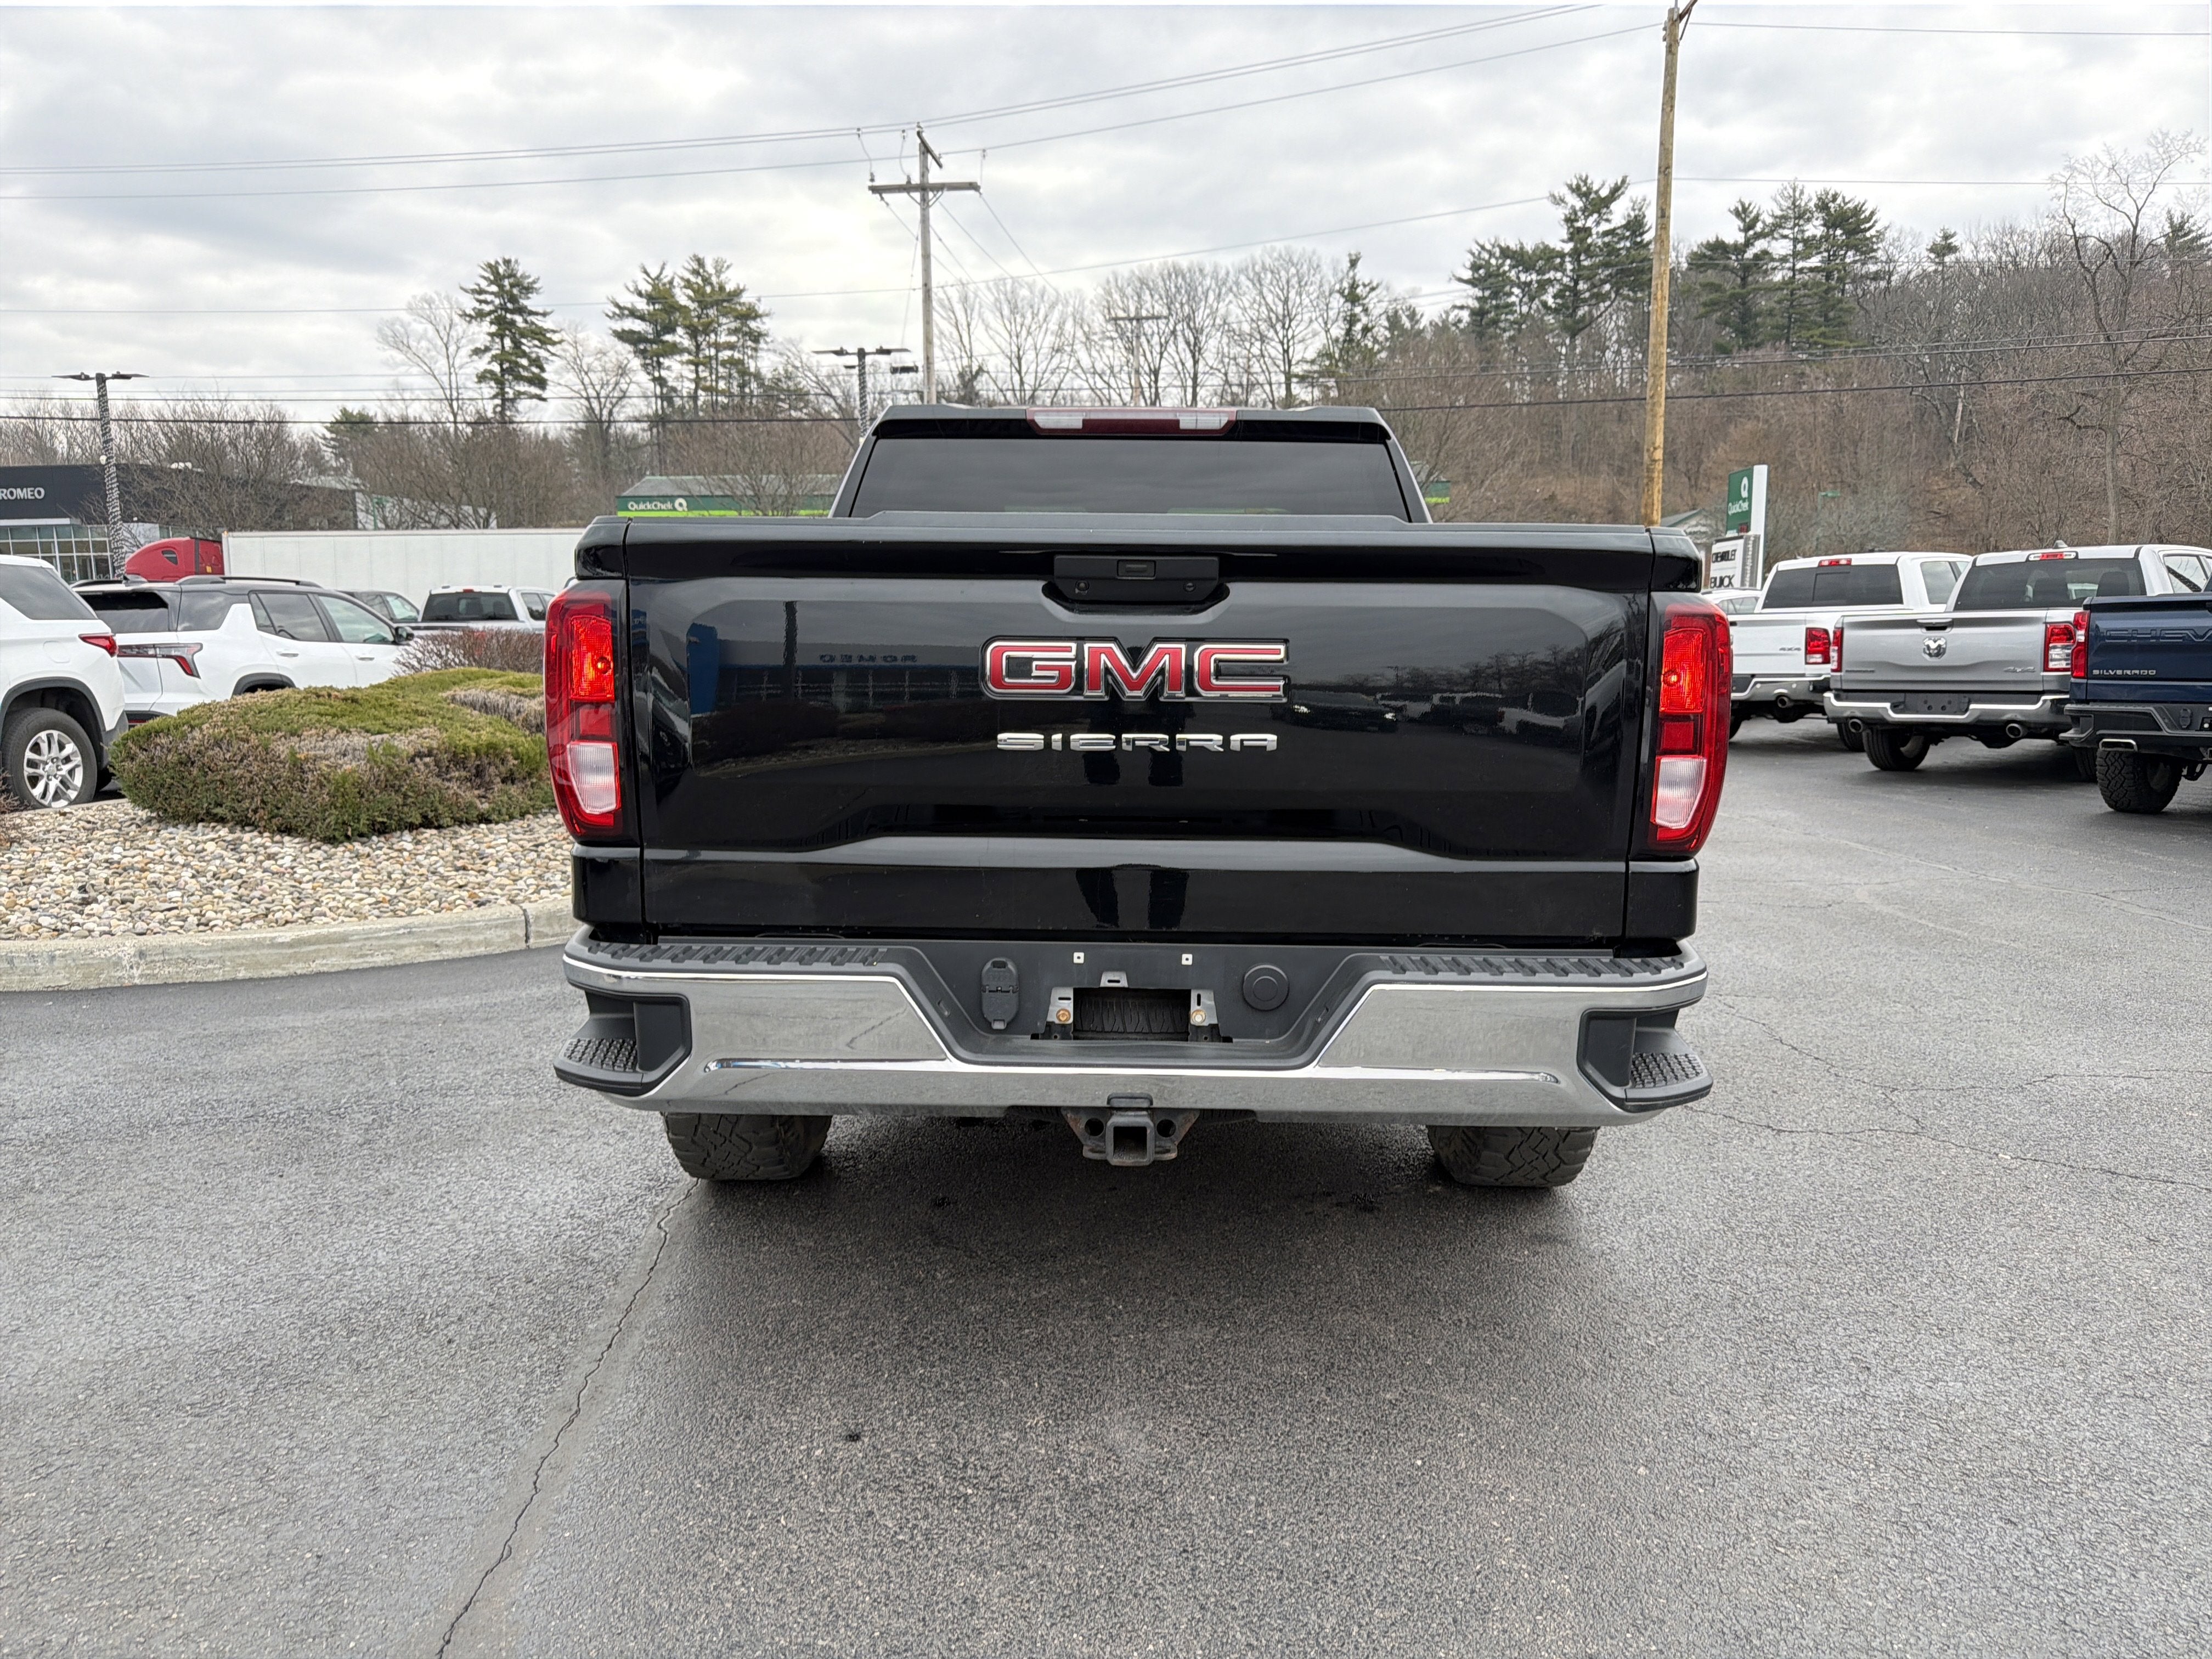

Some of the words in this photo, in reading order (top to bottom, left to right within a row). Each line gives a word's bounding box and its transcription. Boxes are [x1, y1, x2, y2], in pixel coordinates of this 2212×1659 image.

[0, 487, 45, 500] ROMEO
[628, 501, 673, 511] QuickChek
[1710, 574, 1735, 589] BUICK
[985, 641, 1287, 699] GMC
[997, 732, 1278, 752] SIERRA
